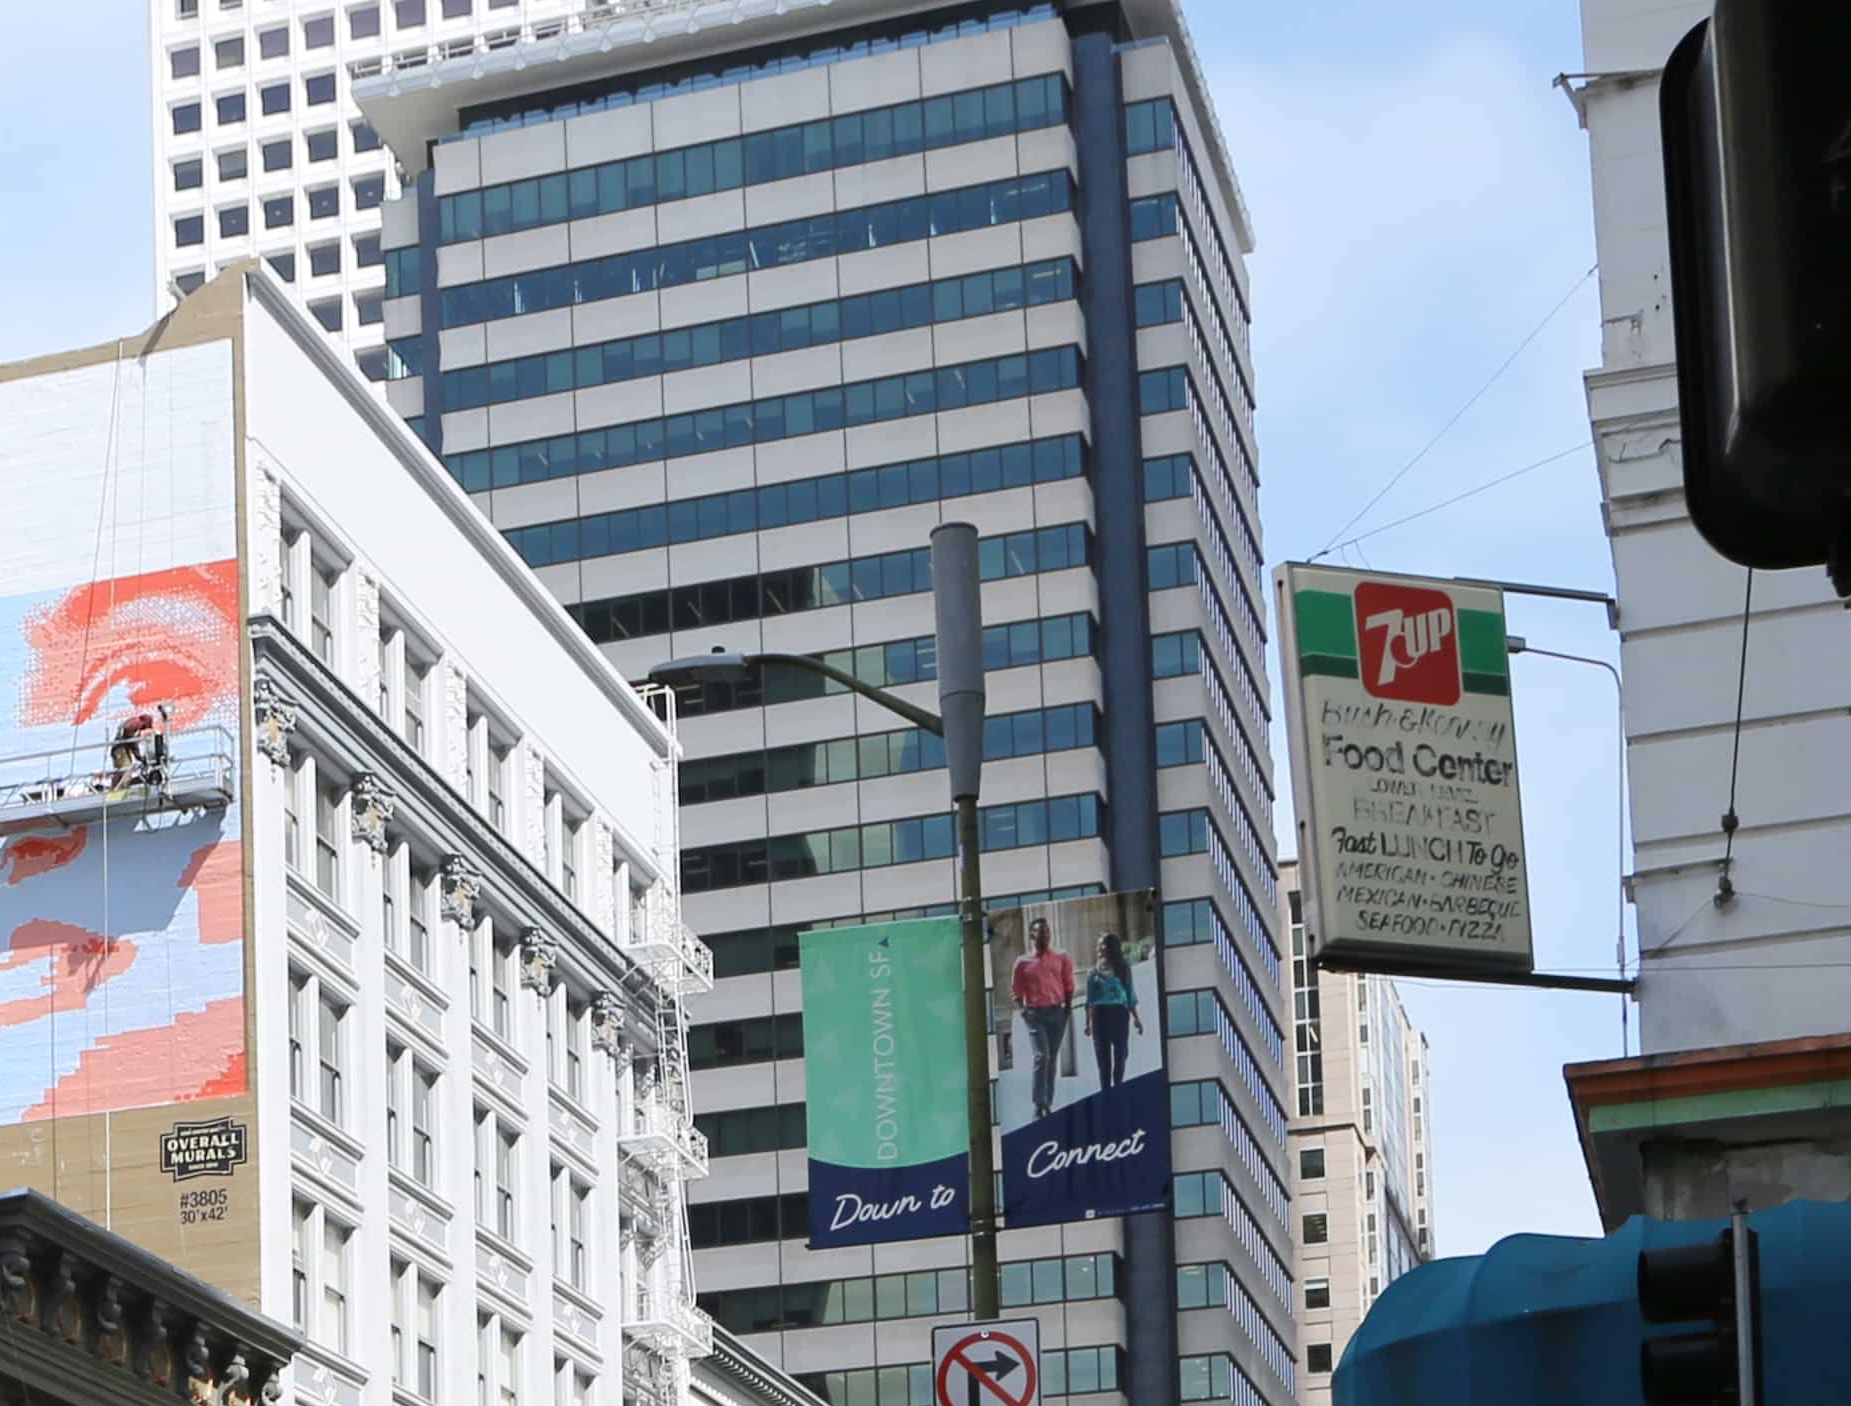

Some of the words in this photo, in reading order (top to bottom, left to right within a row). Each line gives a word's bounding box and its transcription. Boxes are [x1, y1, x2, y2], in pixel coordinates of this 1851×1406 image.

[1364, 606, 1452, 687] 7UP
[1322, 734, 1405, 775] Food
[1412, 743, 1513, 788] Center
[1331, 826, 1378, 855] Fast
[1380, 831, 1463, 865] LUNCH
[1466, 840, 1488, 866] To
[1335, 860, 1428, 886] AMERICAN
[1440, 870, 1519, 895] CHINESE
[1336, 885, 1422, 909] MEXICAN
[1429, 894, 1522, 922] BARBEQUE
[1357, 910, 1440, 936] SEAFOOD
[869, 951, 892, 979] SF
[871, 987, 899, 1162] DOWNTOWN
[166, 1132, 240, 1151] OVERALL
[170, 1147, 237, 1165] MURALS
[1026, 1127, 1147, 1179] Connect
[180, 1188, 228, 1209] #3805
[829, 1188, 923, 1232] Down
[930, 1182, 956, 1211] to
